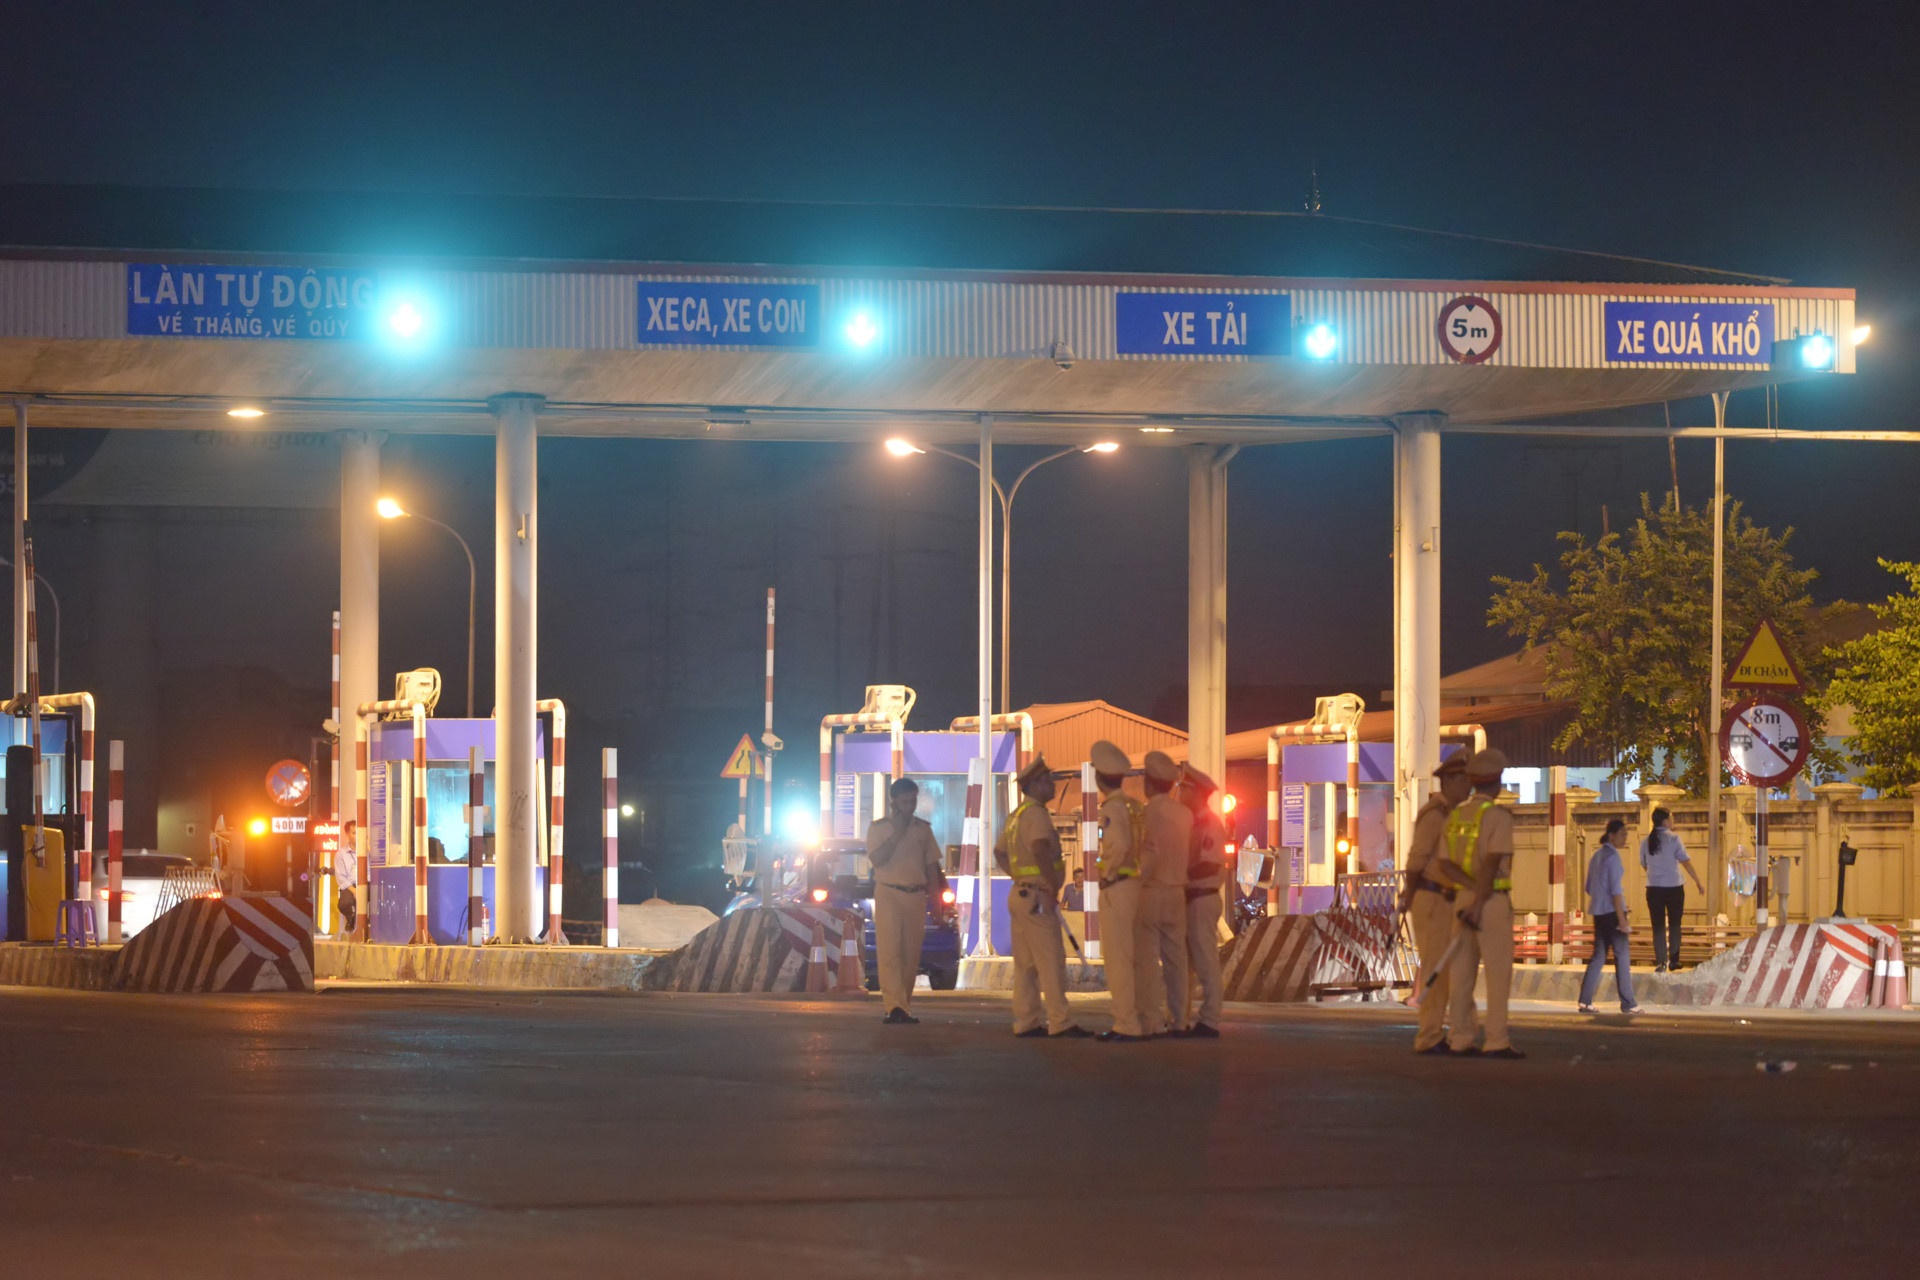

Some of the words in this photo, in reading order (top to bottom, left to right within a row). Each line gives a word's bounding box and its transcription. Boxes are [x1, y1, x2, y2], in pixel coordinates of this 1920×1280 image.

[133, 264, 205, 305] LÀN
[215, 270, 263, 315] TỰ
[271, 267, 377, 317] ĐỘNG
[157, 310, 182, 334] VÉ
[722, 298, 751, 333] XE
[757, 297, 806, 333] CON
[1162, 311, 1196, 345] XE
[1206, 301, 1247, 346] TẢI
[1616, 320, 1646, 354] XE
[1652, 312, 1704, 355] QUÁ
[1711, 309, 1761, 356] KHỔ
[1739, 665, 1752, 676] ĐI
[1753, 663, 1789, 679] CHẬM
[1753, 708, 1781, 725] 8m
